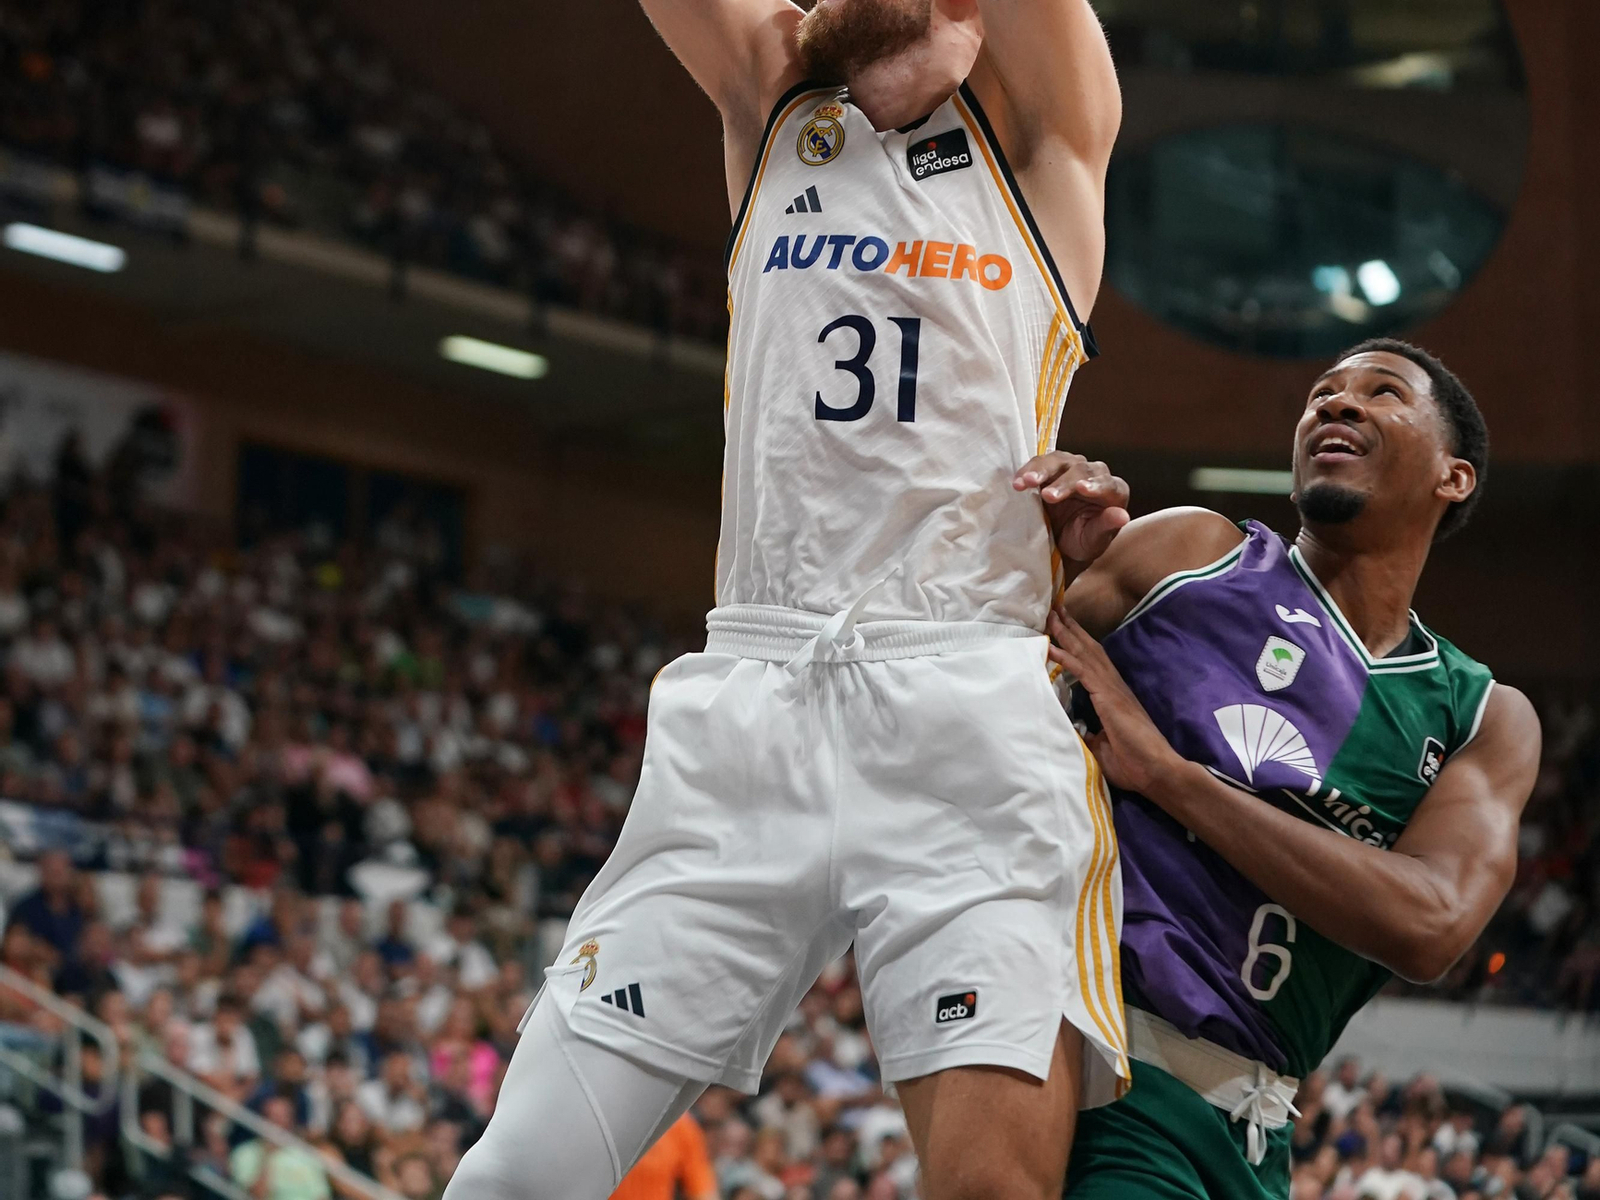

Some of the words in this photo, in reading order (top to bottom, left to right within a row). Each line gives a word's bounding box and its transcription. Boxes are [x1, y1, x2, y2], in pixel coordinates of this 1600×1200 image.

[912, 150, 937, 166] liga
[915, 153, 969, 176] endesa
[762, 234, 1013, 291] AUTOHERO
[814, 314, 921, 423] 31
[1241, 903, 1297, 1001] 6
[938, 1002, 969, 1021] acb
